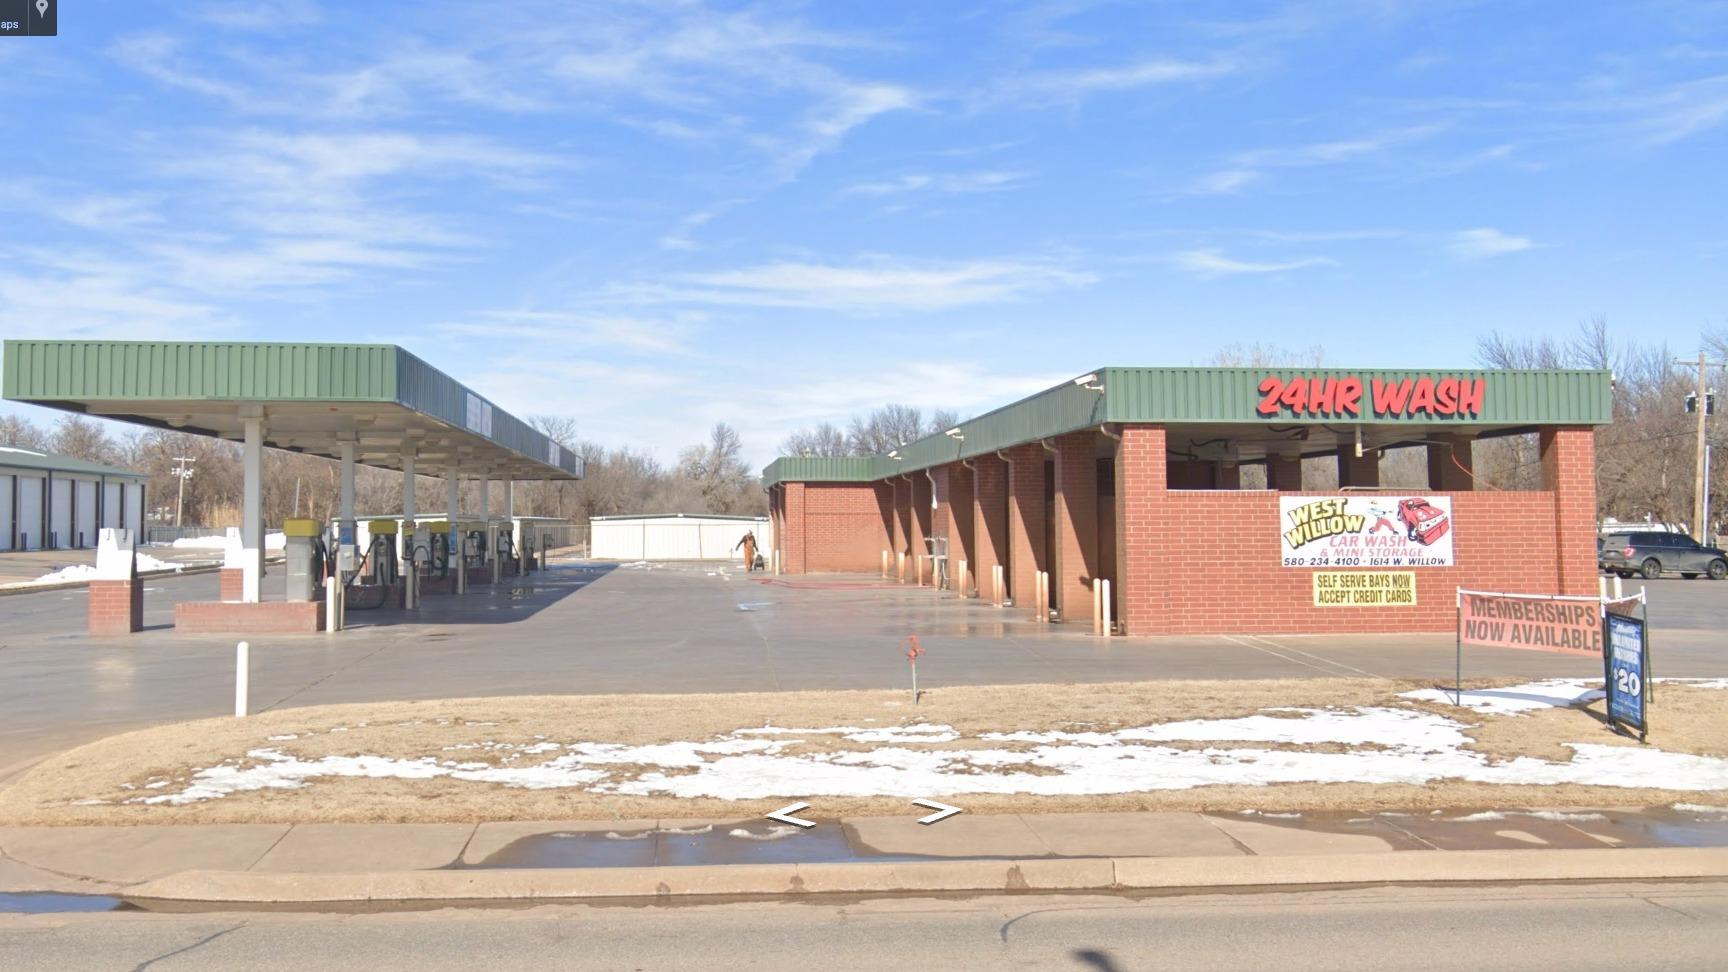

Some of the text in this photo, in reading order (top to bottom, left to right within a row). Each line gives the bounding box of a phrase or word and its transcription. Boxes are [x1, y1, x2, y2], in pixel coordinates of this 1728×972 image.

[1256, 375, 1486, 420] 24HR WASH
[1287, 497, 1348, 526] WEST
[1283, 515, 1365, 549] WILLOW
[1329, 535, 1408, 547] CAR WASH
[1284, 557, 1446, 566] 580-234-4100 1614 W. WILLOW
[1319, 548, 1424, 557] & MINI STORAGE
[1317, 574, 1411, 588] SELF SERVE BAYS NOW
[1318, 590, 1412, 603] ACCEPT CREDIT CARDS
[1470, 598, 1596, 627] MEMBERSHIPS
[1465, 620, 1505, 642] NOW
[1510, 624, 1601, 652] AVAILABLE
